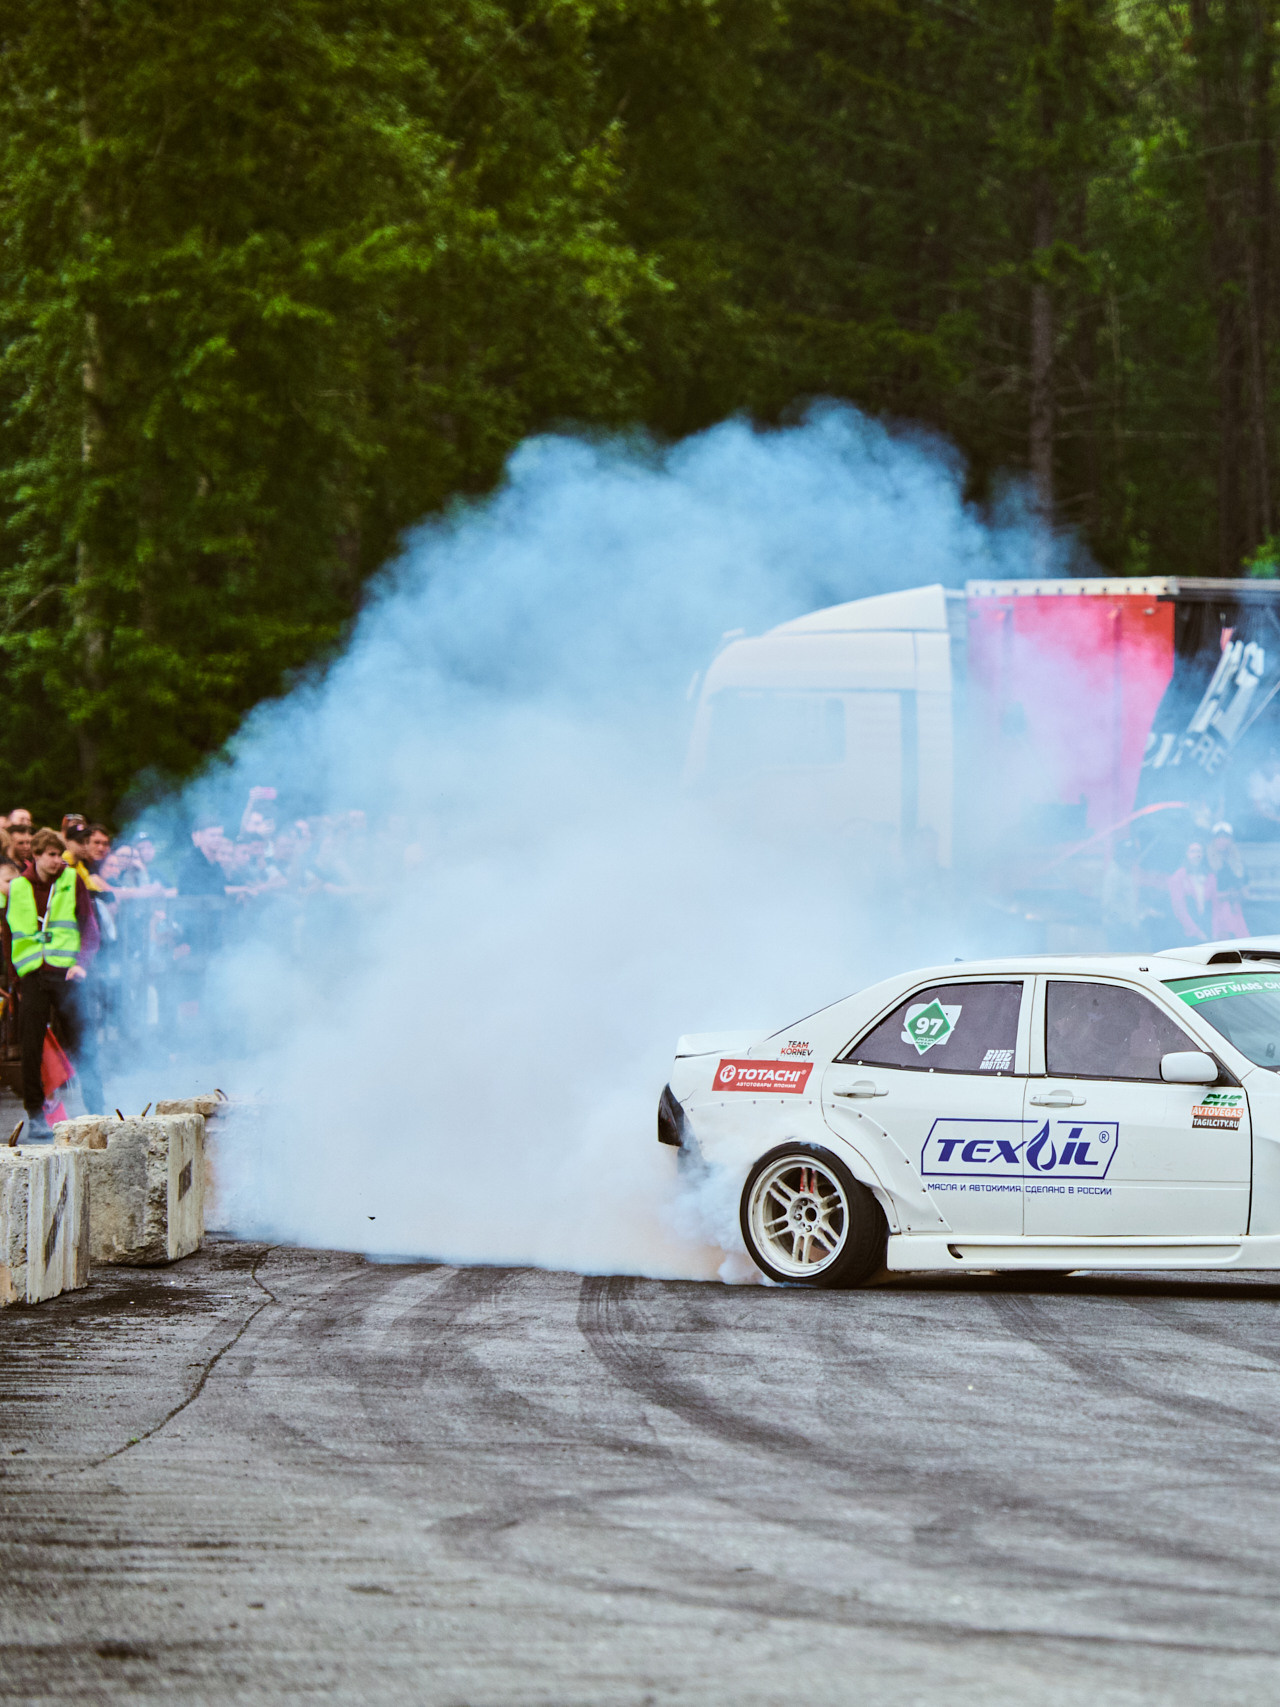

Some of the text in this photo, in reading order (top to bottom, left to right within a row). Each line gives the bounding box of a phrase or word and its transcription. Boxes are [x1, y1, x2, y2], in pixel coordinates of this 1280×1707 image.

[1193, 985, 1228, 1000] DRIFT
[1228, 982, 1263, 992] WARS
[914, 1017, 944, 1036] 97
[788, 1040, 810, 1048] TEAM
[780, 1048, 814, 1056] KORNEV
[737, 1069, 801, 1082] TOTACHI
[1192, 1106, 1243, 1118] AVTOVEGAS
[1193, 1118, 1240, 1129] TAGILCITY.RU
[927, 1183, 958, 1191] МАСЛА
[1025, 1185, 1066, 1194] СДЕЛАНО
[1068, 1186, 1075, 1194] В
[1077, 1187, 1112, 1196] РОССИИ
